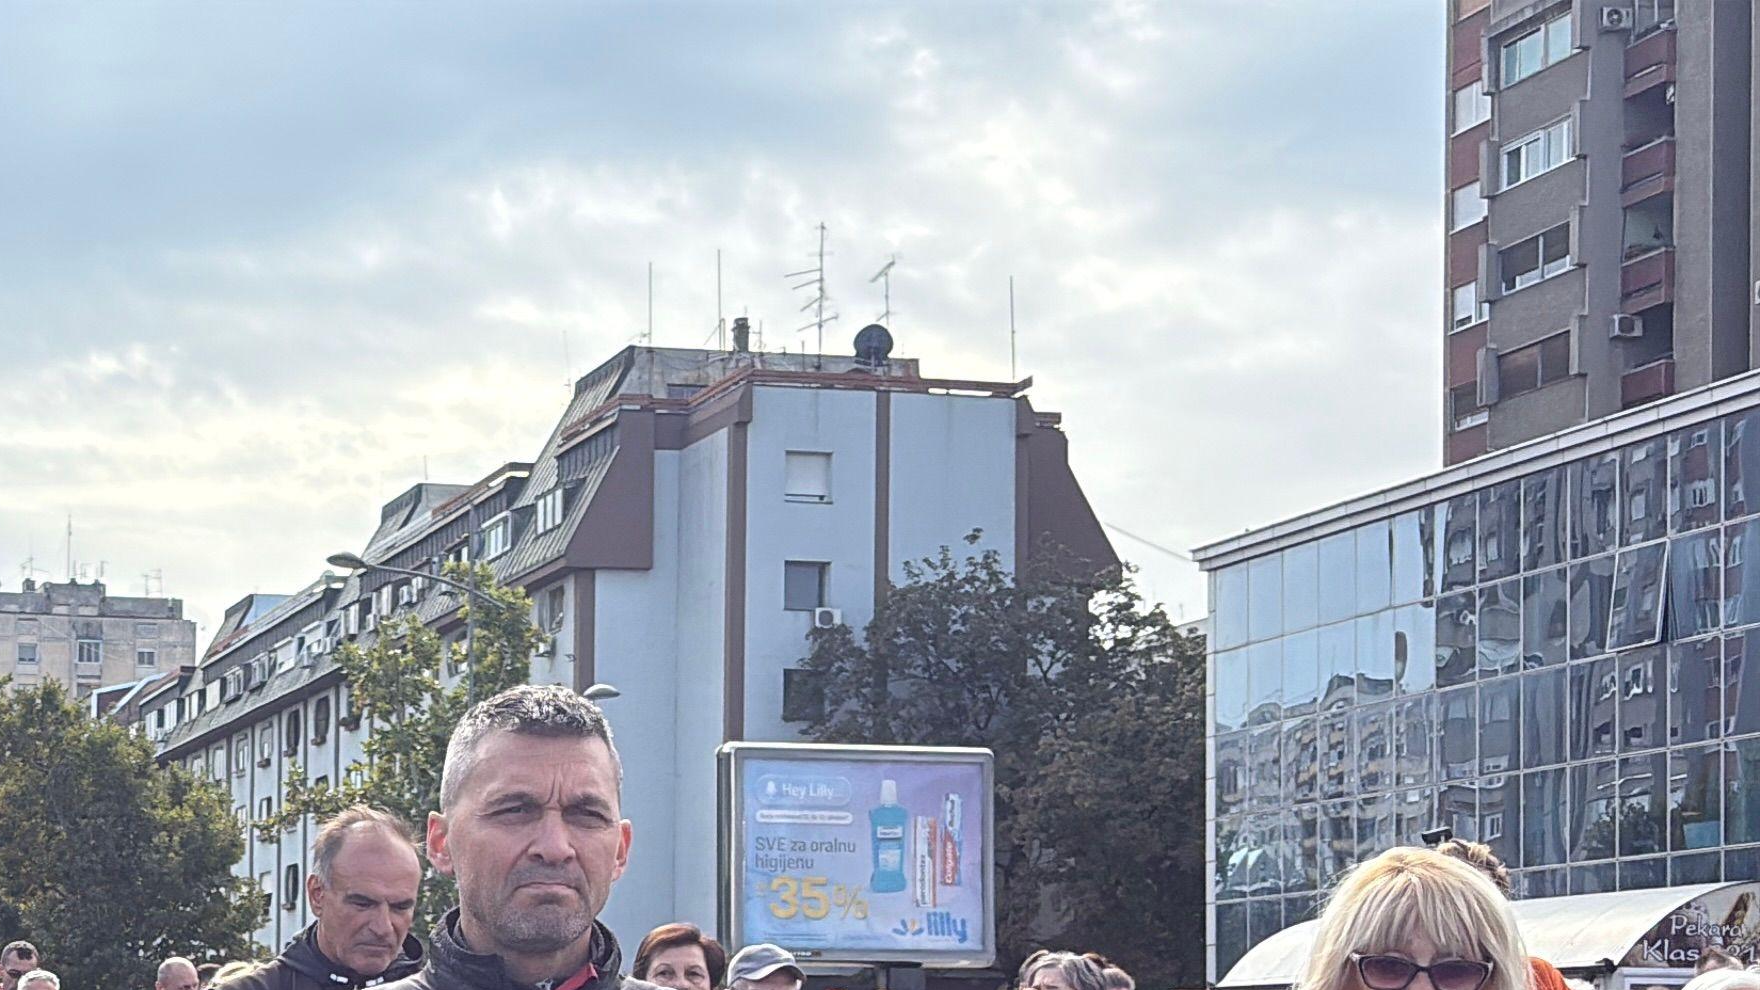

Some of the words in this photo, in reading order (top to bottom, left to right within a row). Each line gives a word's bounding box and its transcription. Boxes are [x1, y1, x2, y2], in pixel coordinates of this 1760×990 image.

[782, 783, 806, 799] Hey
[755, 836, 786, 852] SVE
[790, 840, 806, 852] za
[810, 837, 856, 853] oralnu
[755, 854, 814, 872] higijenu
[927, 911, 967, 943] lilly
[1670, 913, 1745, 937] Pekara
[1643, 938, 1700, 961] Klas
